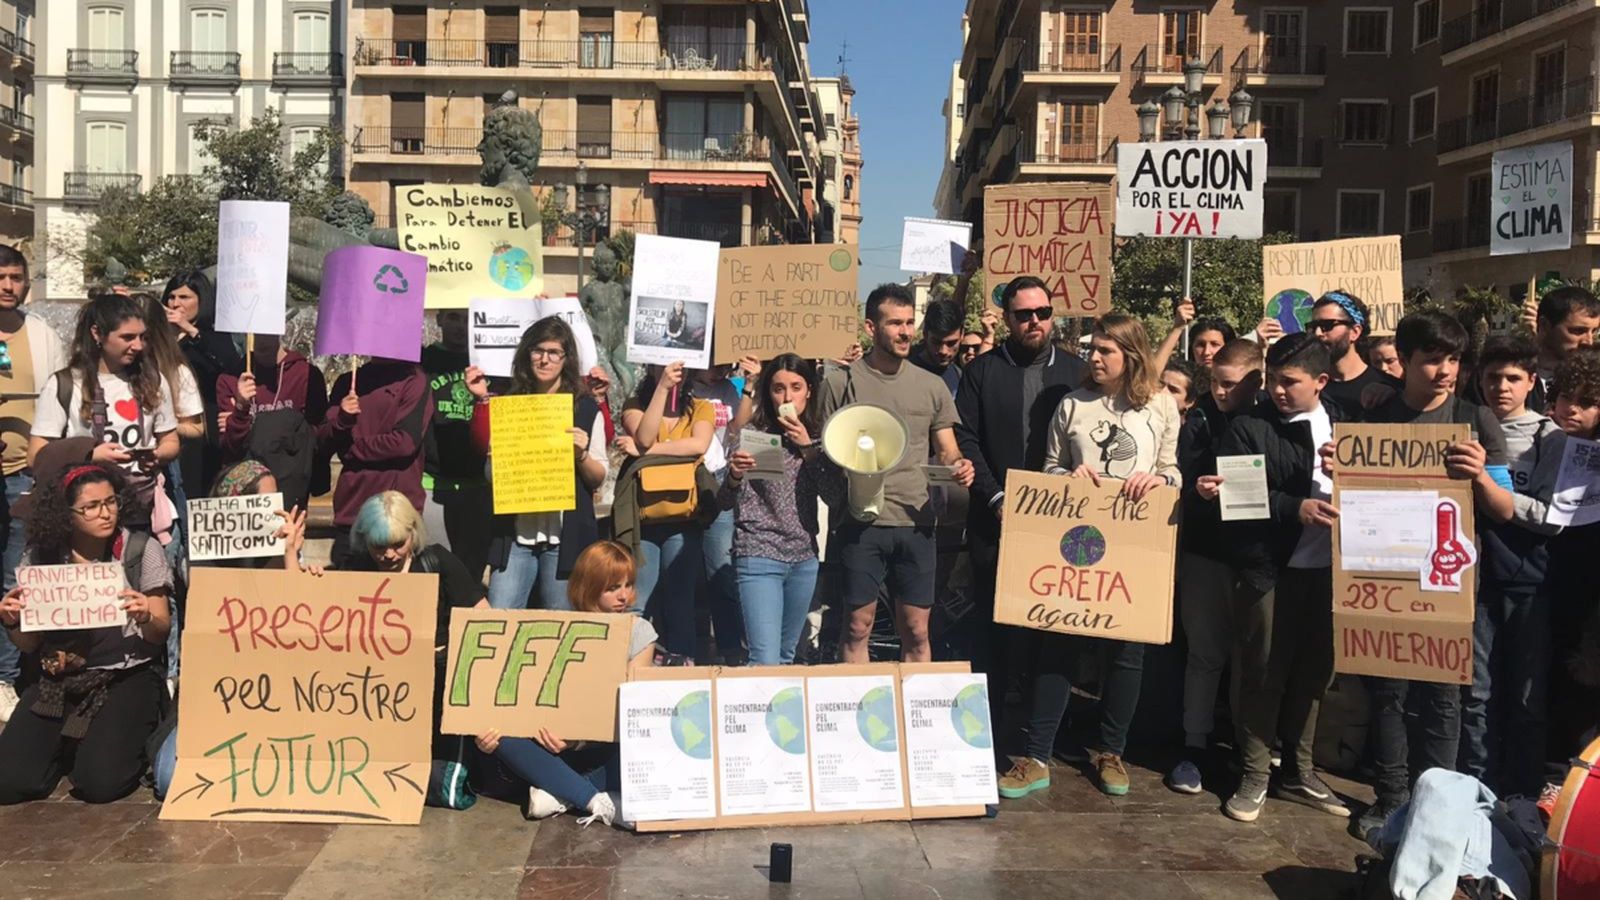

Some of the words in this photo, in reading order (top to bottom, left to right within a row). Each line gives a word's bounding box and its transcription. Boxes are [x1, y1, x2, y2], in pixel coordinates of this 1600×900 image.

[1129, 148, 1253, 191] ACCION
[1499, 158, 1565, 191] ESTIMA
[407, 188, 513, 208] Cambiemos
[1132, 191, 1161, 208] POR
[1169, 192, 1190, 208] EL
[1197, 192, 1244, 210] CLIMA
[1522, 190, 1537, 202] EL
[405, 213, 437, 227] Para
[995, 196, 1104, 238] JUSTICIA
[1496, 203, 1563, 240] CLIMA
[405, 234, 460, 252] Cambio
[988, 237, 1095, 274] CLIMÁTICA
[1268, 249, 1316, 276] RESPETA
[1320, 247, 1336, 274] LA
[1340, 242, 1400, 274] EXISTENCIA
[762, 263, 775, 281] A
[786, 262, 824, 281] PART
[730, 291, 749, 308] OF
[756, 290, 786, 307] THE
[792, 289, 857, 308] SOLUTION
[730, 312, 758, 329] NOT
[764, 311, 798, 328] PART
[802, 312, 822, 329] OF
[829, 314, 856, 333] THE
[1336, 434, 1456, 468] CALENDAR
[193, 512, 264, 532] PLASTIC
[18, 566, 89, 586] CANVIEM
[93, 565, 118, 580] ELS
[1029, 565, 1132, 604] GRETA
[95, 585, 117, 598] NO
[24, 609, 45, 626] EL
[51, 604, 117, 627] CLIMA
[1410, 599, 1436, 613] en
[449, 620, 610, 708] FFF
[1343, 627, 1471, 682] INVIERNO?
[204, 732, 380, 808] FUTUR
